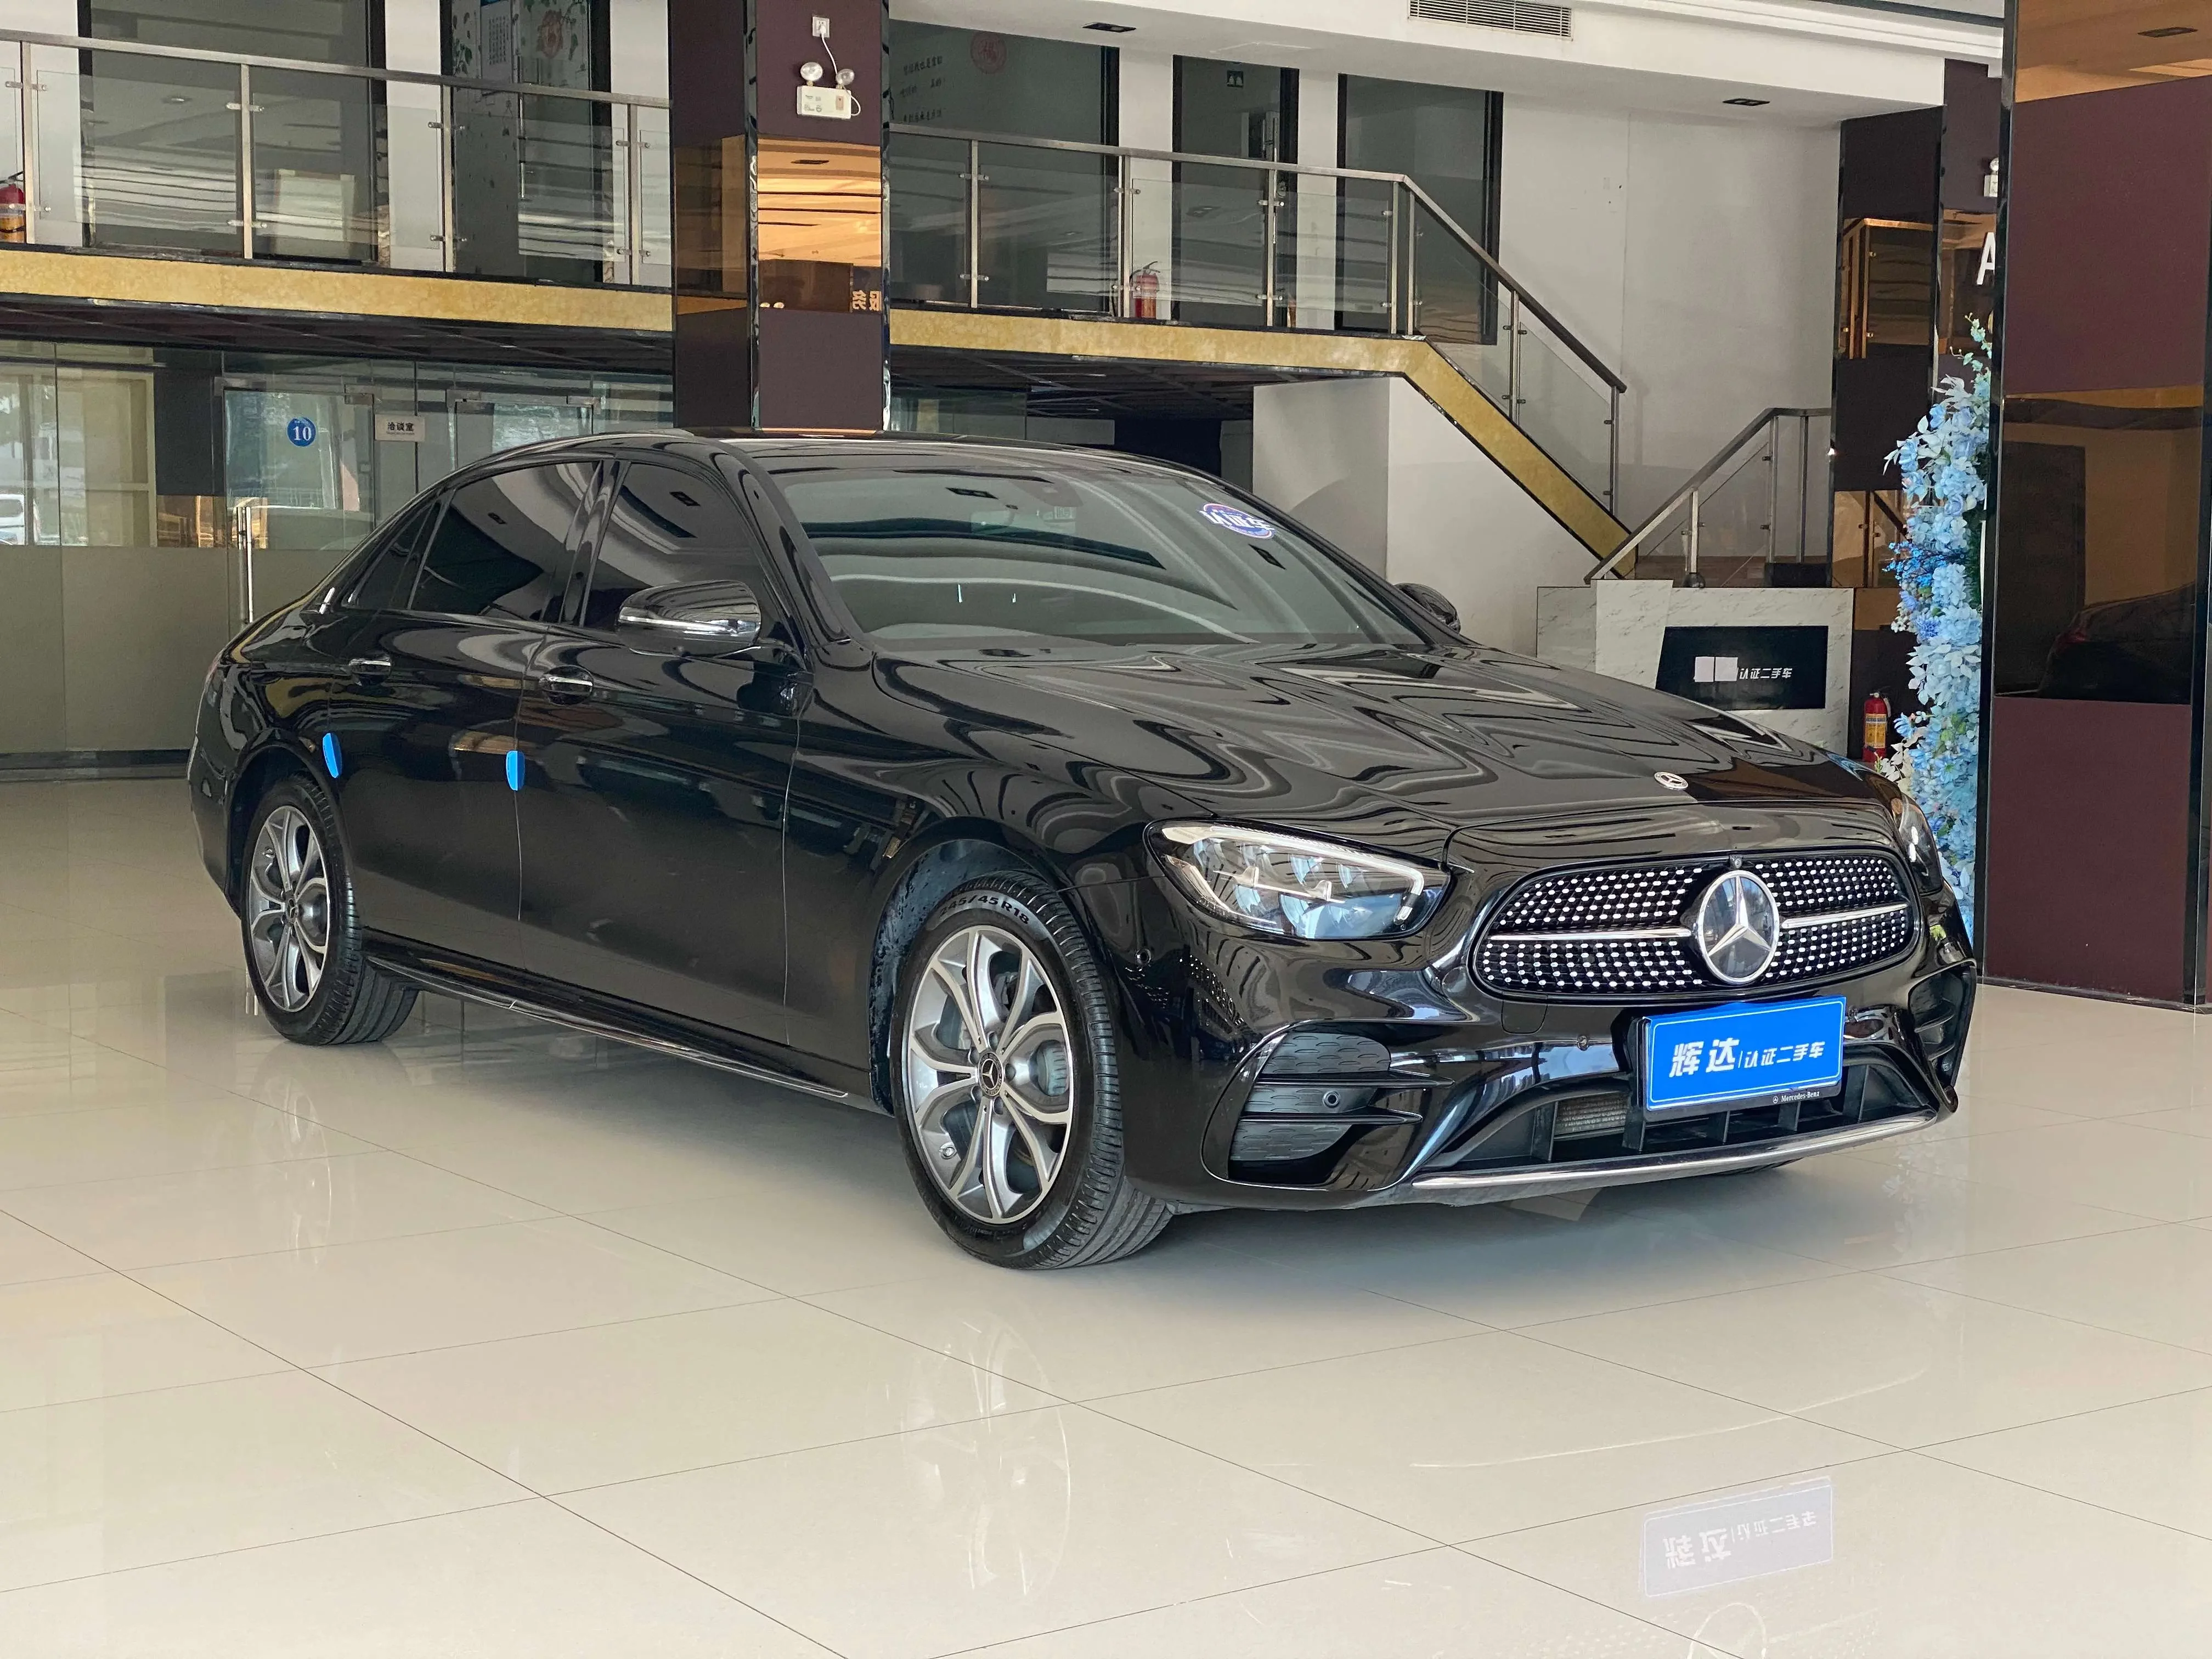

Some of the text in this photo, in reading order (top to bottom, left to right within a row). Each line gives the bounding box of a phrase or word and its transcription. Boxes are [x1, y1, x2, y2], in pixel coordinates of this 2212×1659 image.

[387, 422, 415, 431] 洽谈室
[293, 426, 312, 441] 10
[1739, 668, 1792, 680] 认证二手车
[939, 895, 1030, 924] 245/45 R18
[1669, 1037, 1826, 1078] 辉达 认证二手车
[1781, 1091, 1820, 1102] Mercedes-Benz
